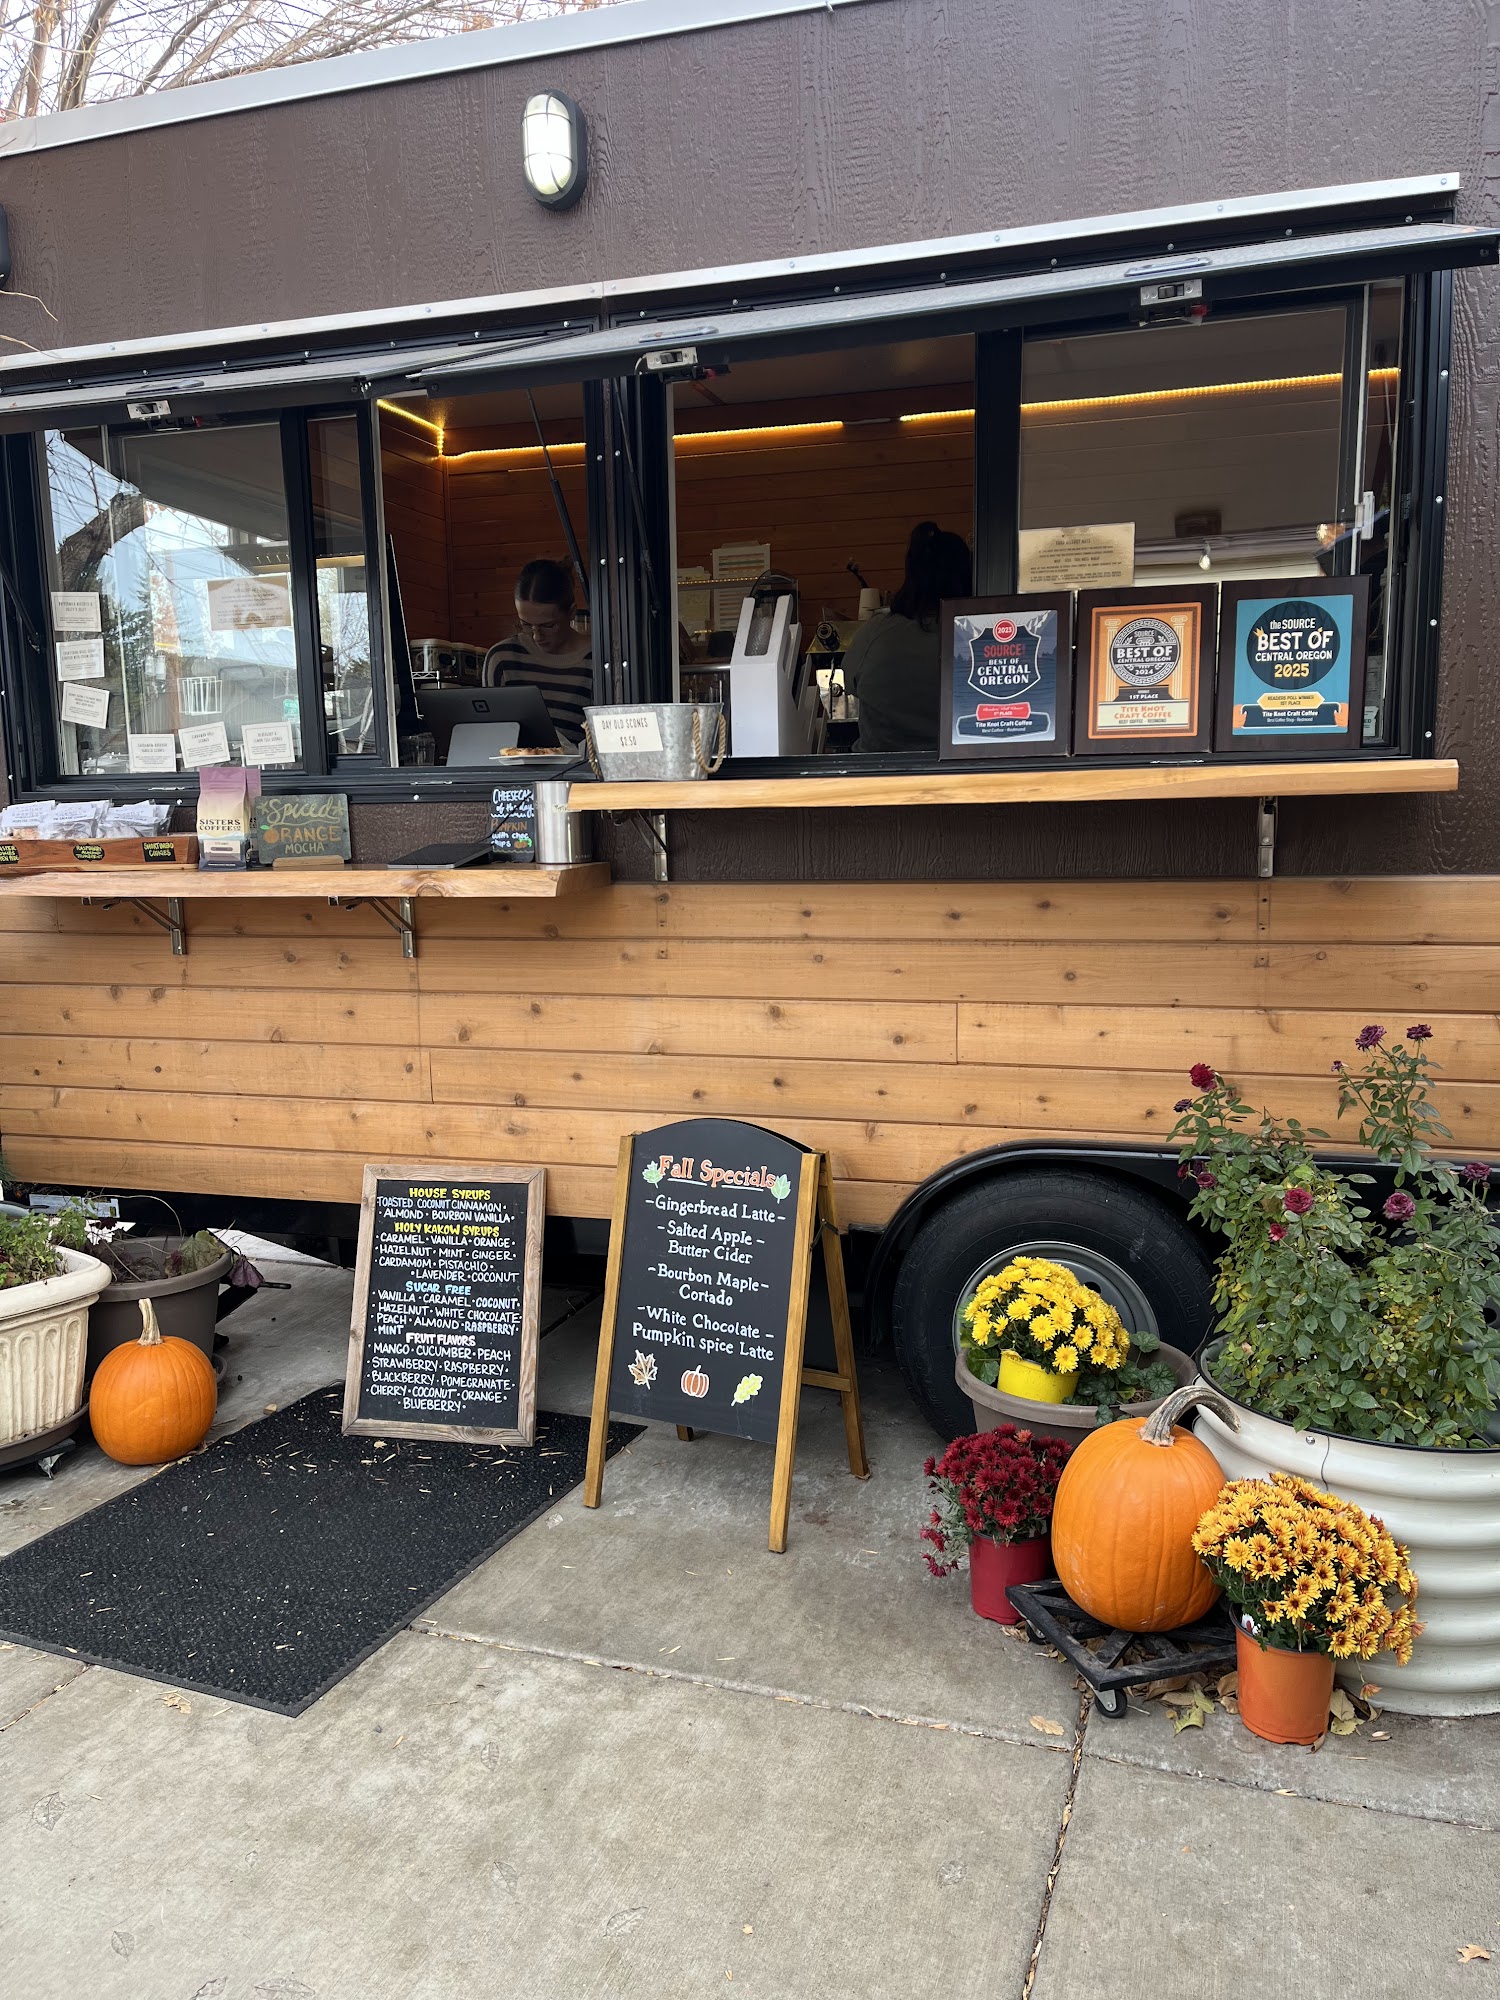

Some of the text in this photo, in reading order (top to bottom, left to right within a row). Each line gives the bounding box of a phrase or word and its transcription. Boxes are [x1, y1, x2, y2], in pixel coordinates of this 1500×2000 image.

[1283, 618, 1316, 629] SOURCE
[1258, 631, 1334, 650] BEST OF
[984, 645, 1021, 657] SOURCE
[1117, 646, 1172, 658] BEST OF
[1255, 650, 1332, 661] CENTRAL OREGON
[978, 664, 1031, 675] CENTRAL
[1274, 663, 1309, 678] 2025
[980, 675, 1028, 685] OREGON
[602, 718, 648, 729] DAY OLD SCONES
[620, 736, 637, 747] $2.50
[267, 795, 340, 825] Spiced
[285, 842, 325, 854] MOCHA
[659, 1155, 776, 1189] Fall Specials
[409, 1188, 491, 1200] HOUSE SYRUPS
[377, 1196, 501, 1212] TOASTED COCONUT CINNAMON
[384, 1209, 511, 1223] ALMOND BOURBON VANILLA
[395, 1223, 499, 1238] HOLY KAKOW SYRUPS
[711, 1228, 752, 1247] Apple
[380, 1233, 510, 1249] CARAMEL VANILLA ORANGE
[380, 1244, 513, 1261] HAZELNUT MINT GINGER
[668, 1240, 753, 1264] Butter Cider
[379, 1257, 488, 1272] CARDAMOM PISTACHIO
[416, 1270, 519, 1283] LAVENDER COCONUT
[406, 1281, 471, 1296] SUGAR FREE
[679, 1284, 733, 1306] Cortado
[378, 1290, 518, 1309] VANILLA CARAMEL COCONUT
[379, 1302, 520, 1322] HAZELNUT WHITE CHOCOLATE
[377, 1313, 515, 1336] PEACH ALMOND RASPBERRY
[378, 1325, 403, 1335] MINT
[692, 1313, 760, 1340] Chocolate
[406, 1332, 476, 1346] FRUIT FLAVORS
[632, 1322, 775, 1361] Pumpkin spice Latte
[374, 1343, 511, 1360] MANGO CUCUMBER PEACH
[373, 1357, 503, 1376] STRAWBERRY RASPBERRY
[372, 1371, 511, 1390] BLACKBERRY POMEGRANATE
[371, 1384, 502, 1403] CHERRY COCONUT ORANGE
[403, 1399, 461, 1413] BLUEBERRY
